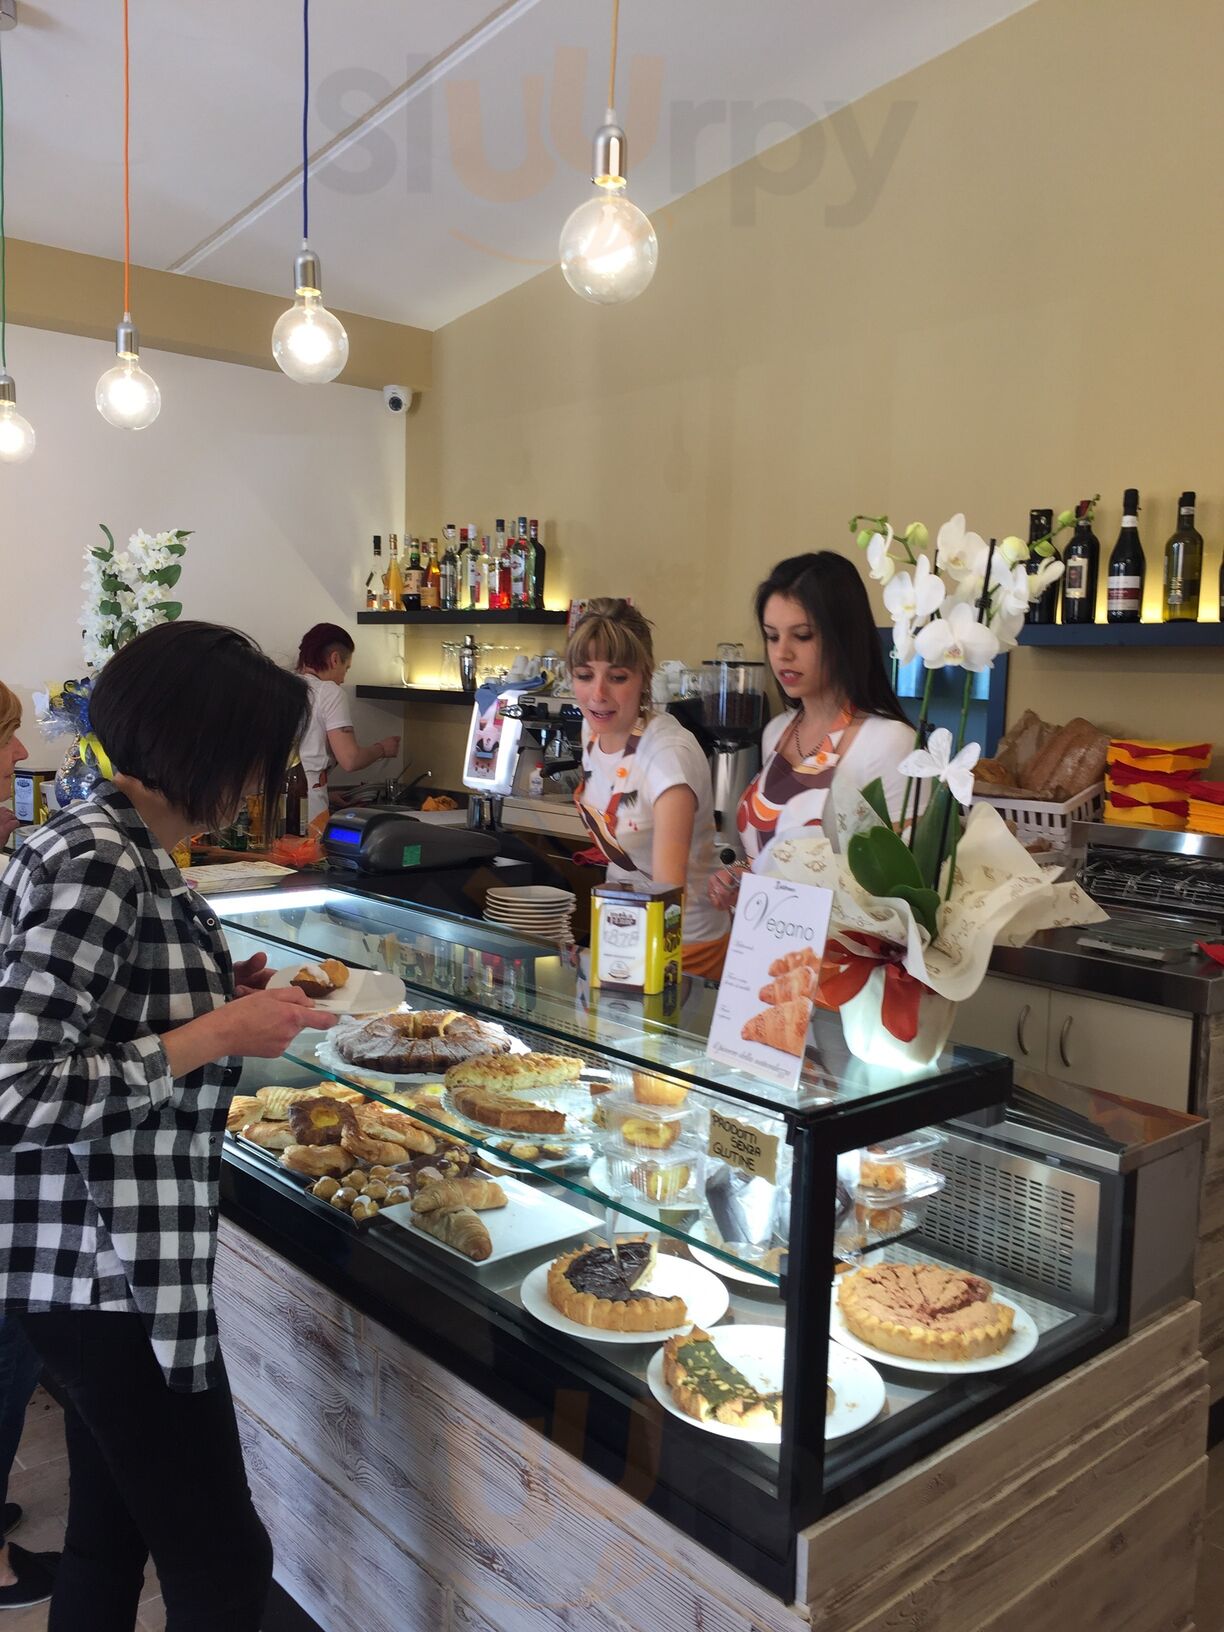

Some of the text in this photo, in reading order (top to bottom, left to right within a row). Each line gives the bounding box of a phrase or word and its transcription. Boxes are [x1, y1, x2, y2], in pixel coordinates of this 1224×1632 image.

[744, 891, 815, 941] Vegano
[712, 1114, 758, 1145] PRODOTTI
[712, 1141, 757, 1172] GLUTINE
